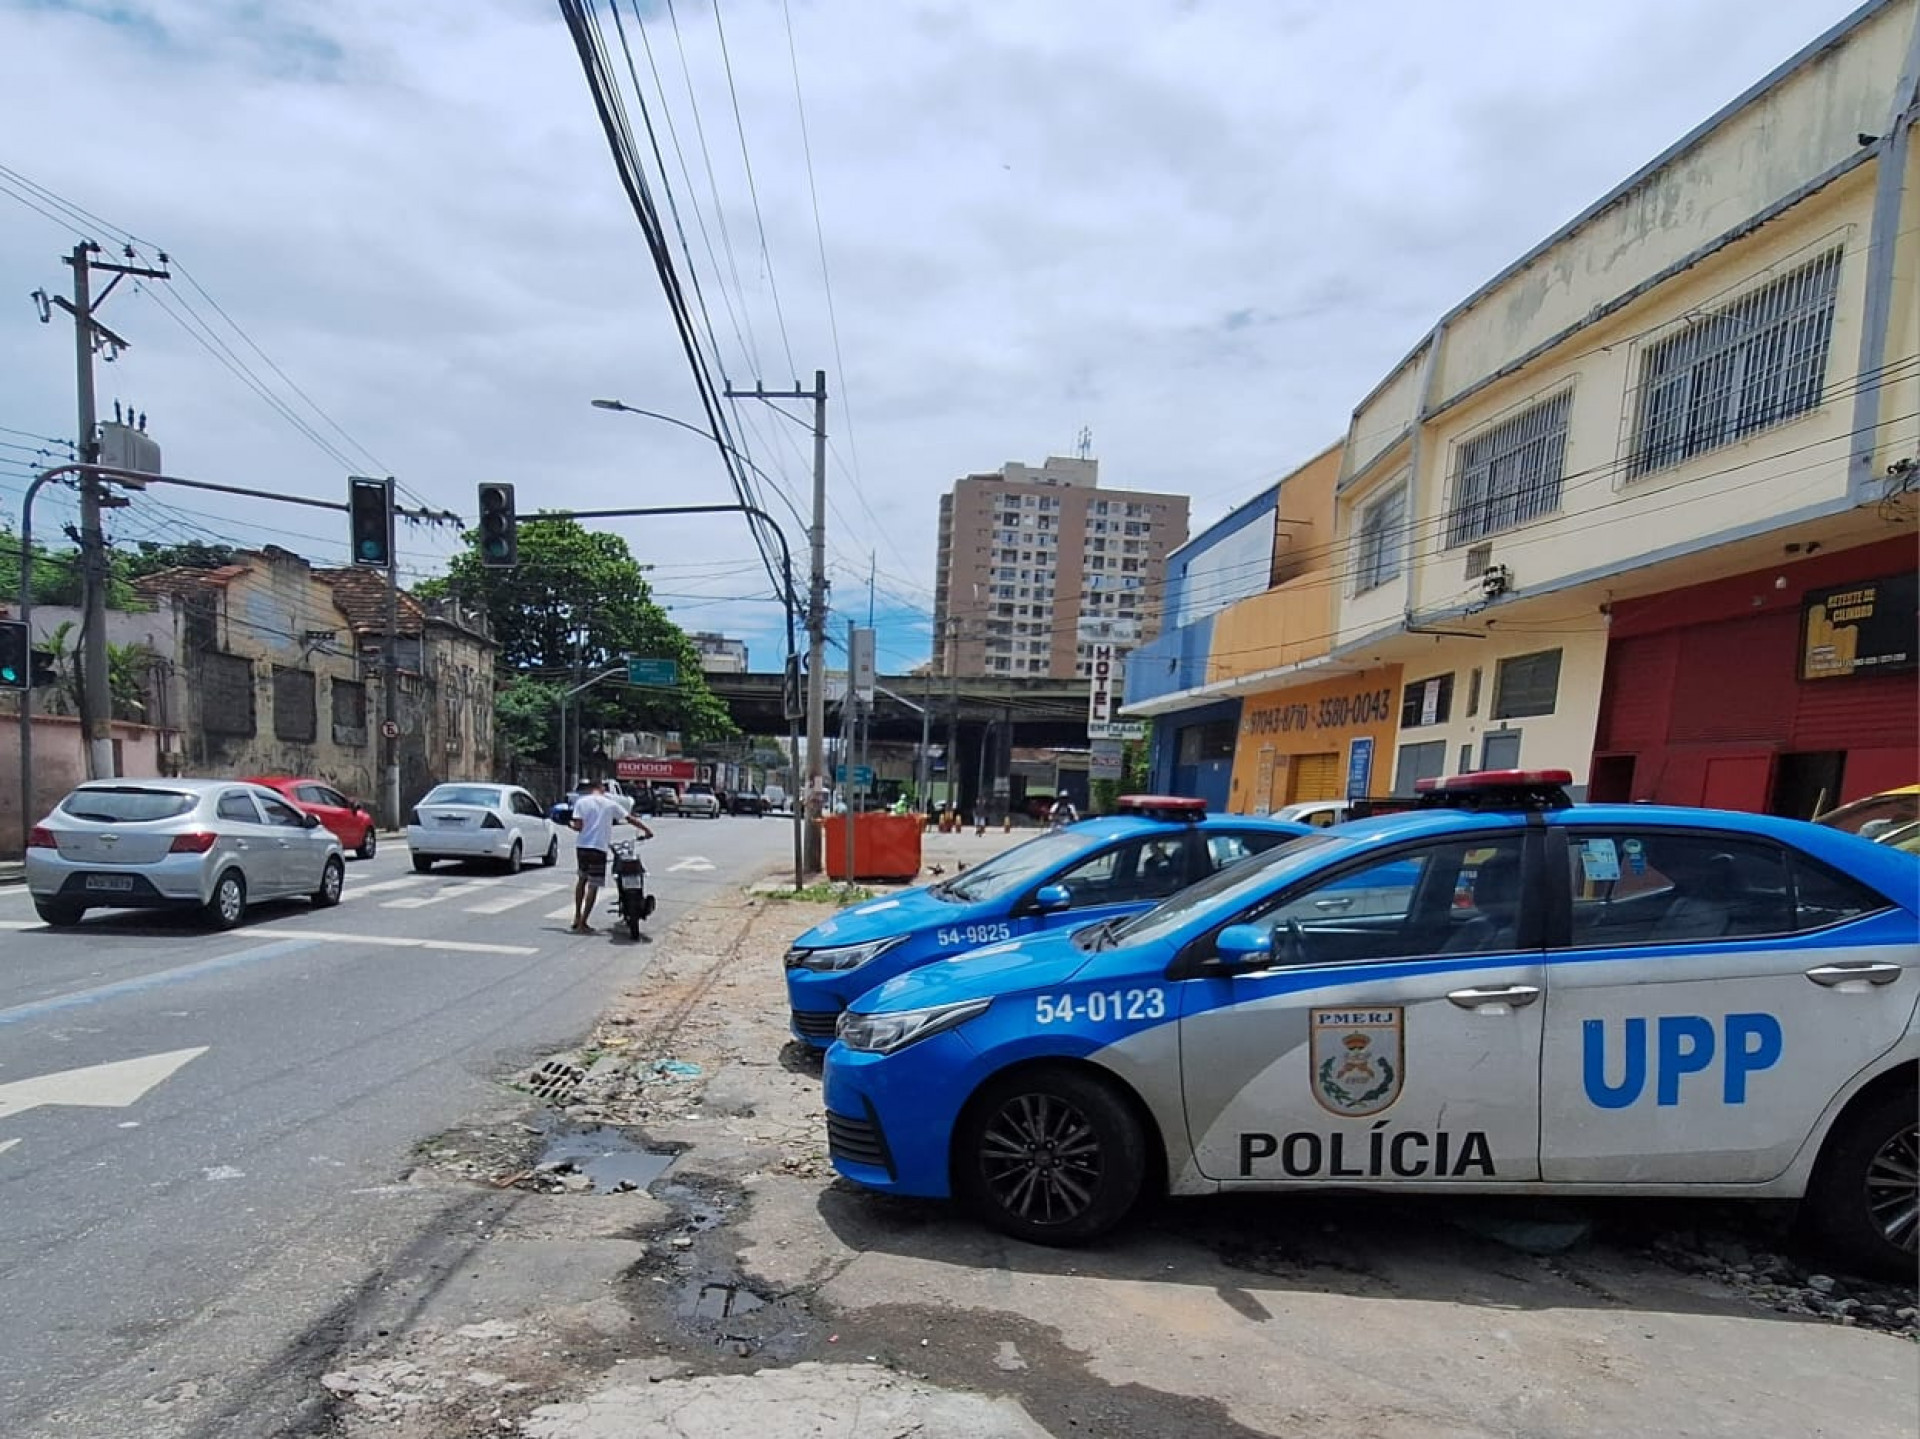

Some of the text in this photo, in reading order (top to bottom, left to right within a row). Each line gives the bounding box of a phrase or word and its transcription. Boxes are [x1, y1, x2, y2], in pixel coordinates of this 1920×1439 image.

[1093, 645, 1111, 720] HOTEL
[1316, 688, 1391, 729] 3580-0043
[937, 922, 1010, 946] 54-9825
[1035, 987, 1166, 1023] 54-0123
[1317, 1011, 1394, 1025] PMERJ
[1582, 1012, 1783, 1109] UPP
[1239, 1119, 1496, 1177] POLÍCIA
